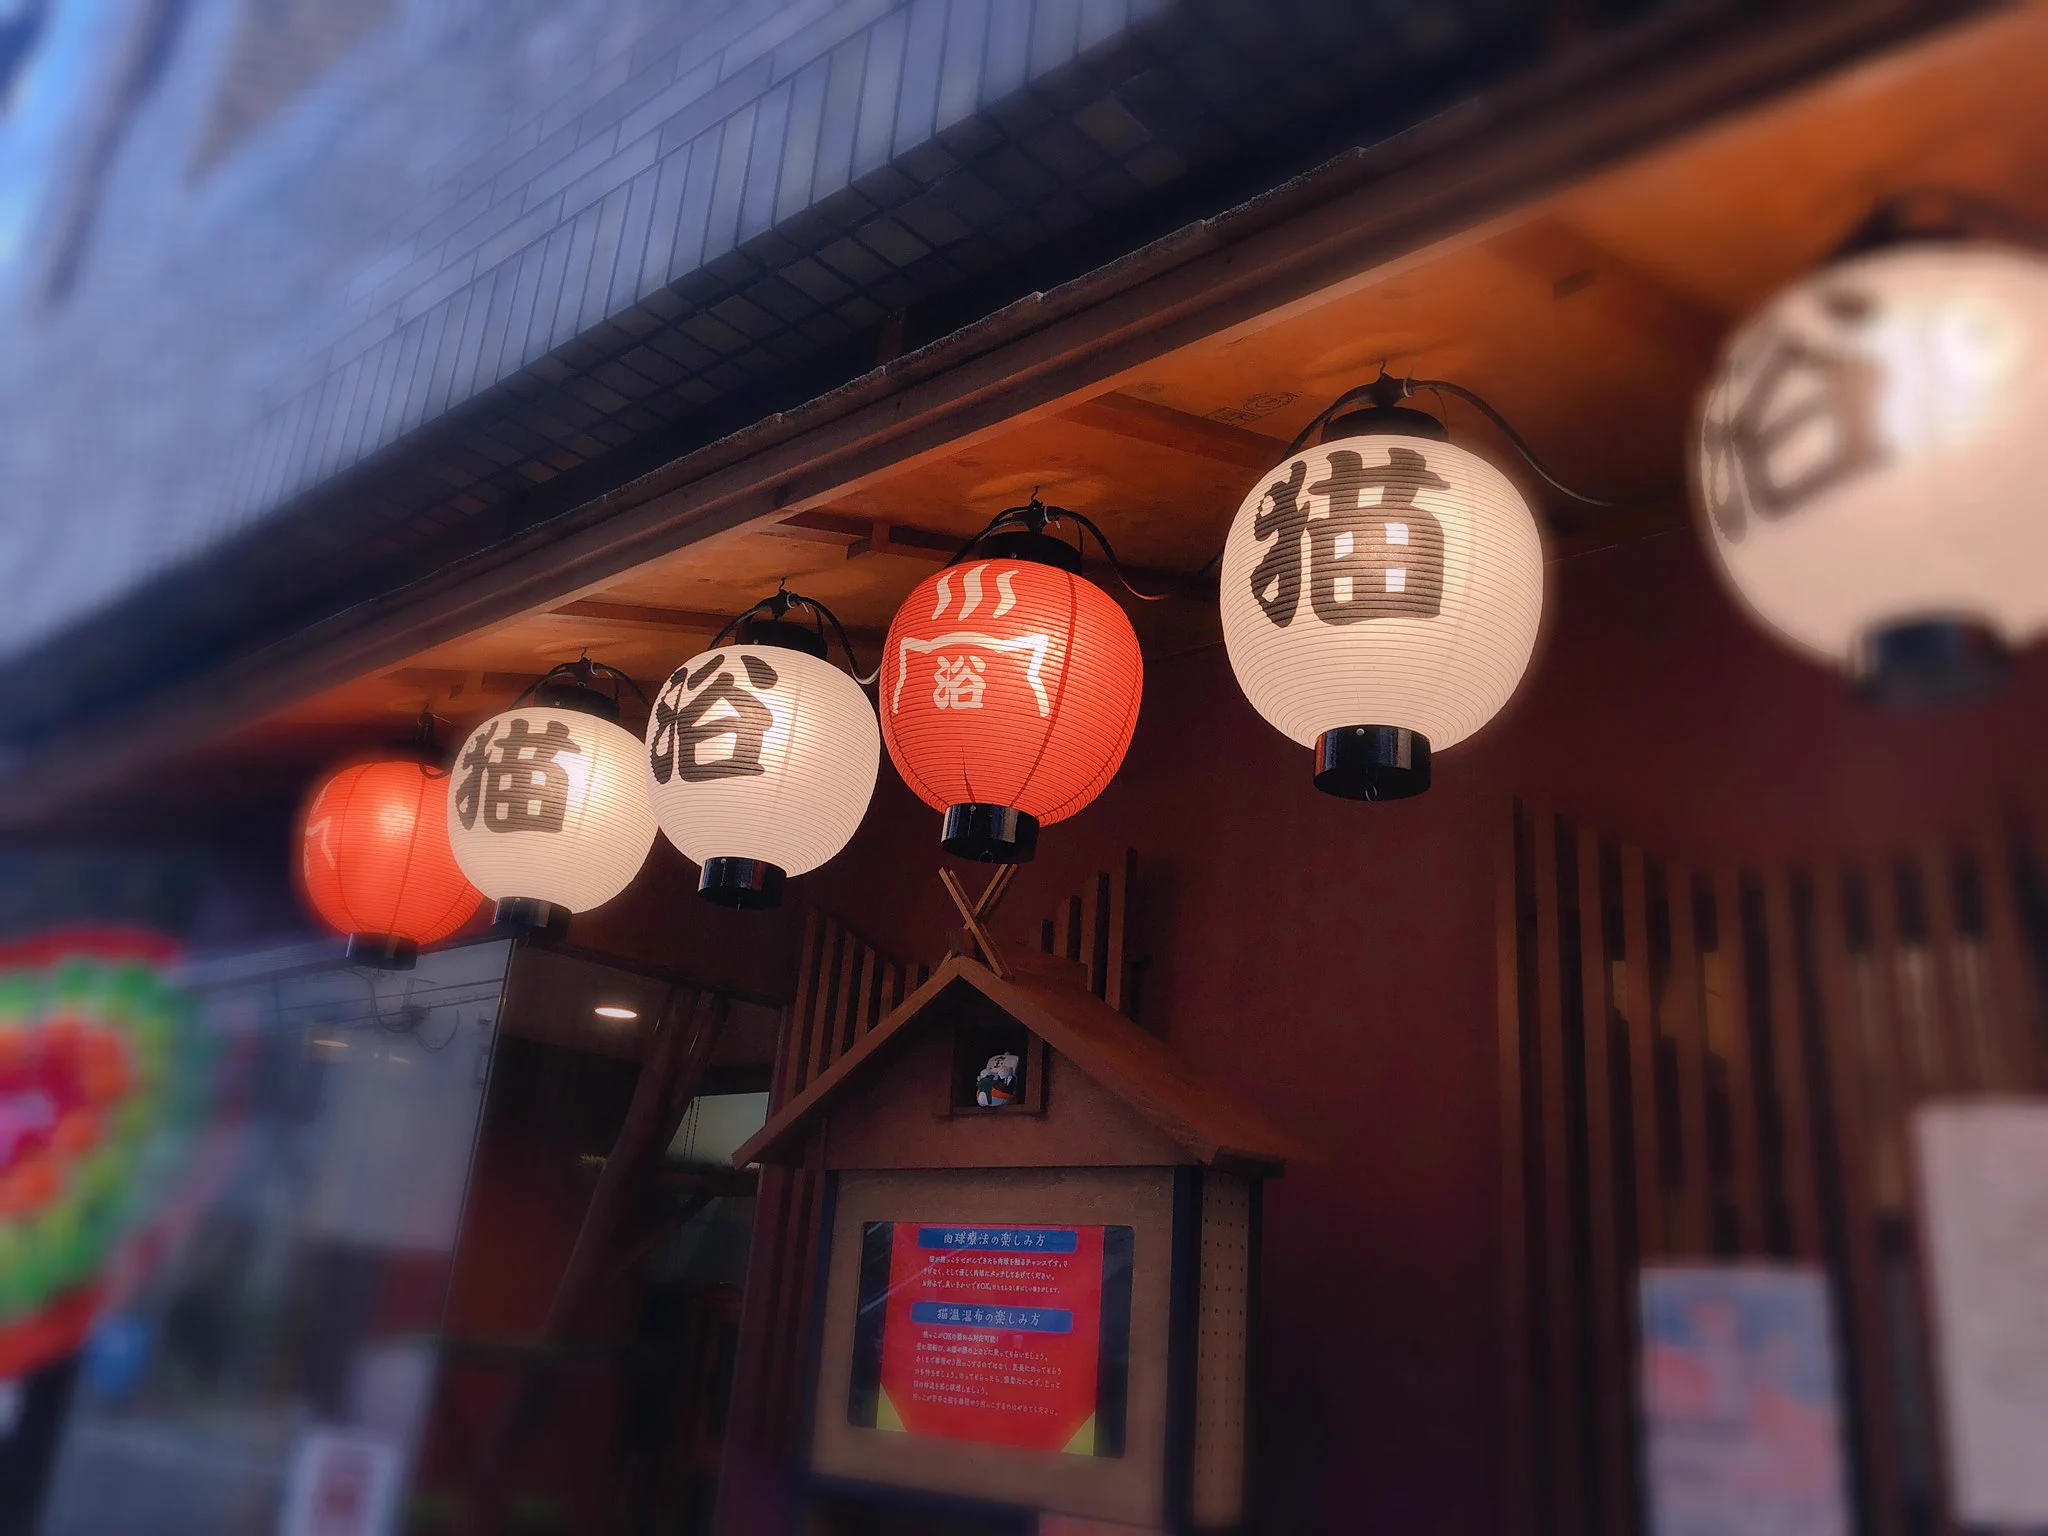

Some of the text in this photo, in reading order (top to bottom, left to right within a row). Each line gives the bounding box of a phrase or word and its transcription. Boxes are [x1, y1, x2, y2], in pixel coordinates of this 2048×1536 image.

[1250, 447, 1450, 628] 猫
[649, 654, 778, 784] 浴
[933, 655, 987, 710] 浴
[455, 717, 581, 833] 猫
